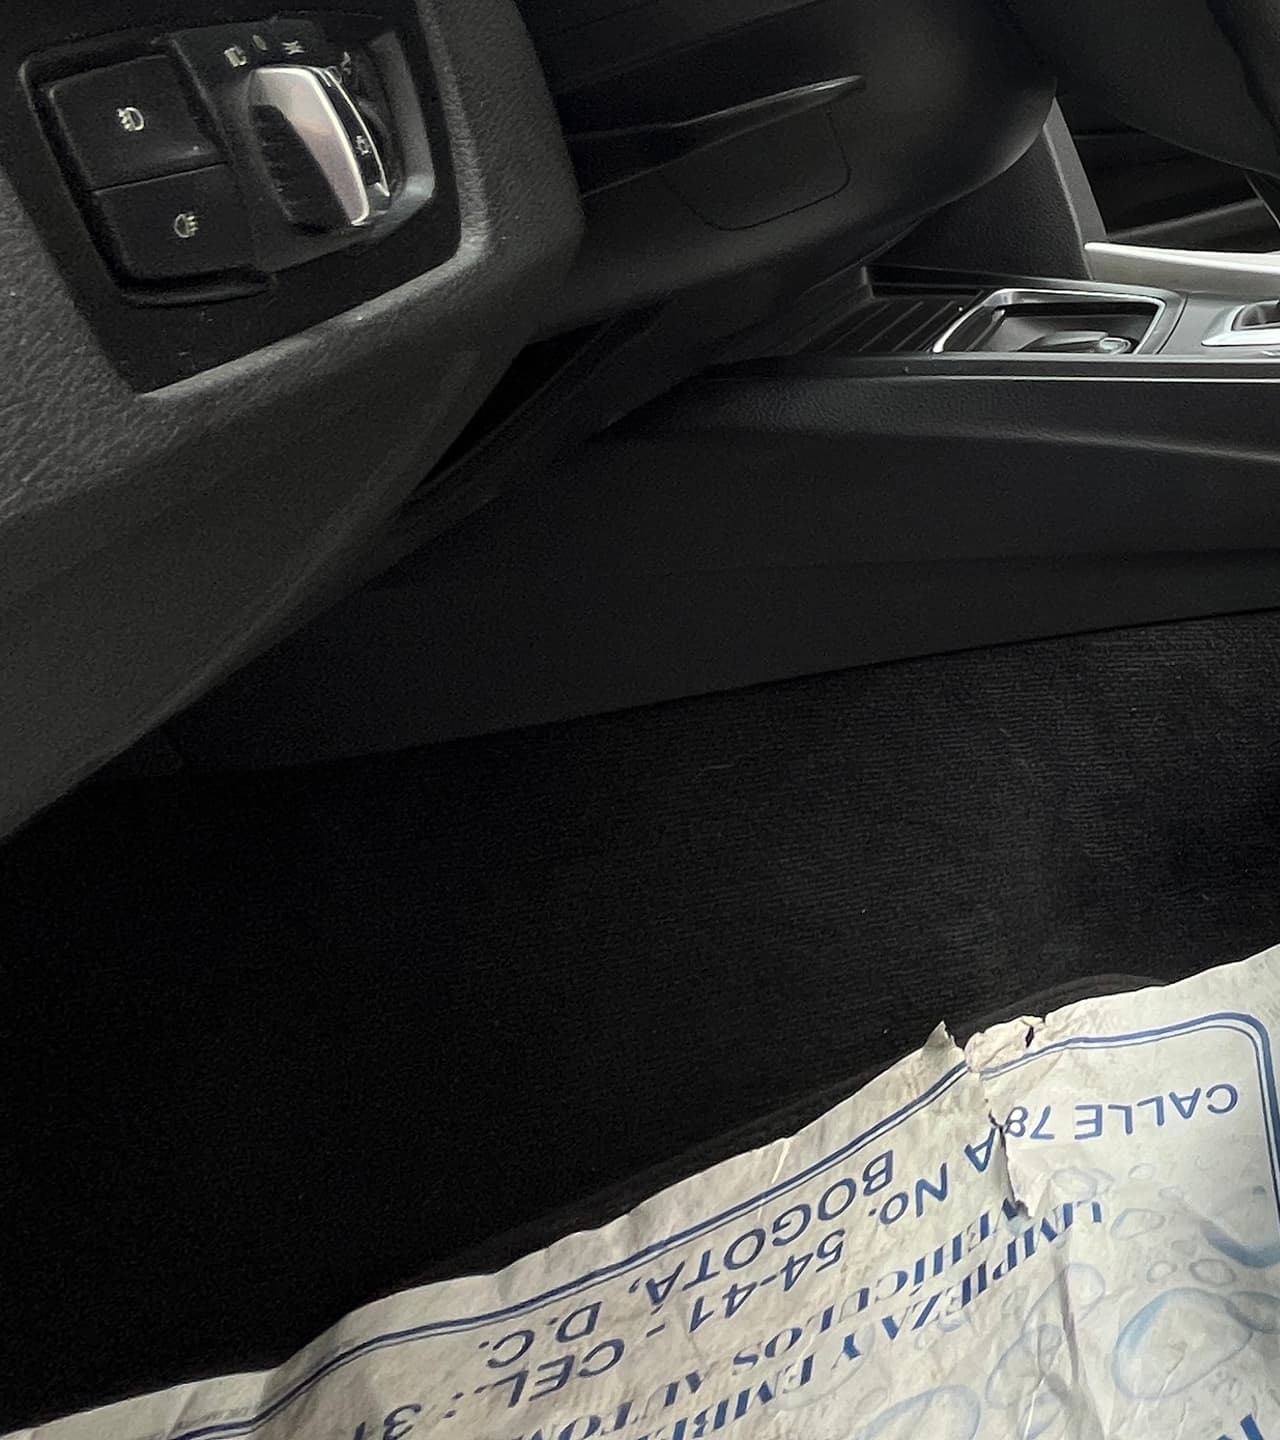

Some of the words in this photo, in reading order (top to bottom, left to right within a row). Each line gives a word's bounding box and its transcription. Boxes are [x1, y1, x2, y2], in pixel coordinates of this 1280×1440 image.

[1074, 1083, 1239, 1140] CALLE
[628, 1149, 894, 1316] BOGOTÁ,
[868, 1162, 947, 1226] No.
[690, 1228, 846, 1333] 54-41
[881, 1200, 1103, 1341] LIMPIEZA
